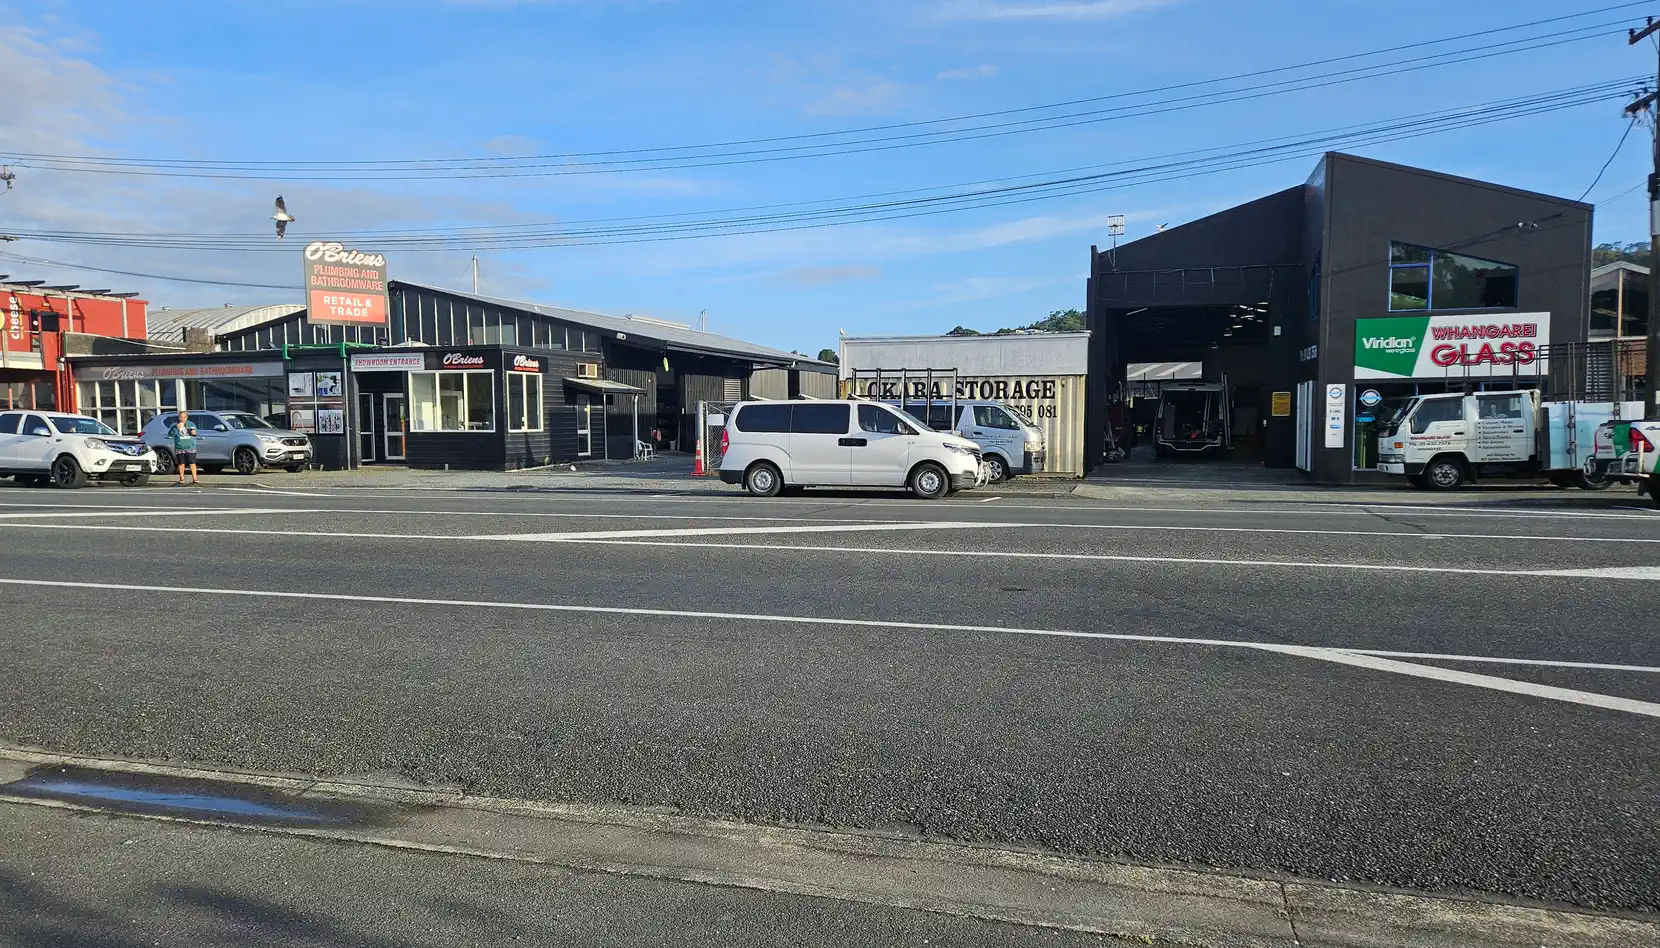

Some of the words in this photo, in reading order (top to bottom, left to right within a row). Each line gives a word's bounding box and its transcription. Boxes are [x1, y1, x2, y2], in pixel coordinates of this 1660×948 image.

[314, 265, 359, 277] PLUMBING
[361, 270, 379, 279] AND
[311, 276, 383, 290] BATHROOMWARE
[324, 296, 364, 307] RETAIL
[365, 299, 373, 307] &
[329, 306, 368, 317] TRADE
[1430, 323, 1537, 340] WHANGAREI
[1362, 337, 1413, 349] Viridian
[1430, 341, 1536, 367] GLASS
[390, 358, 421, 366] ENTRANCE
[152, 367, 183, 376] PLUMBING
[185, 367, 198, 375] AND
[200, 365, 253, 375] BATHROOMWARE
[955, 380, 1056, 399] STORAGE
[1038, 405, 1057, 418] 081
